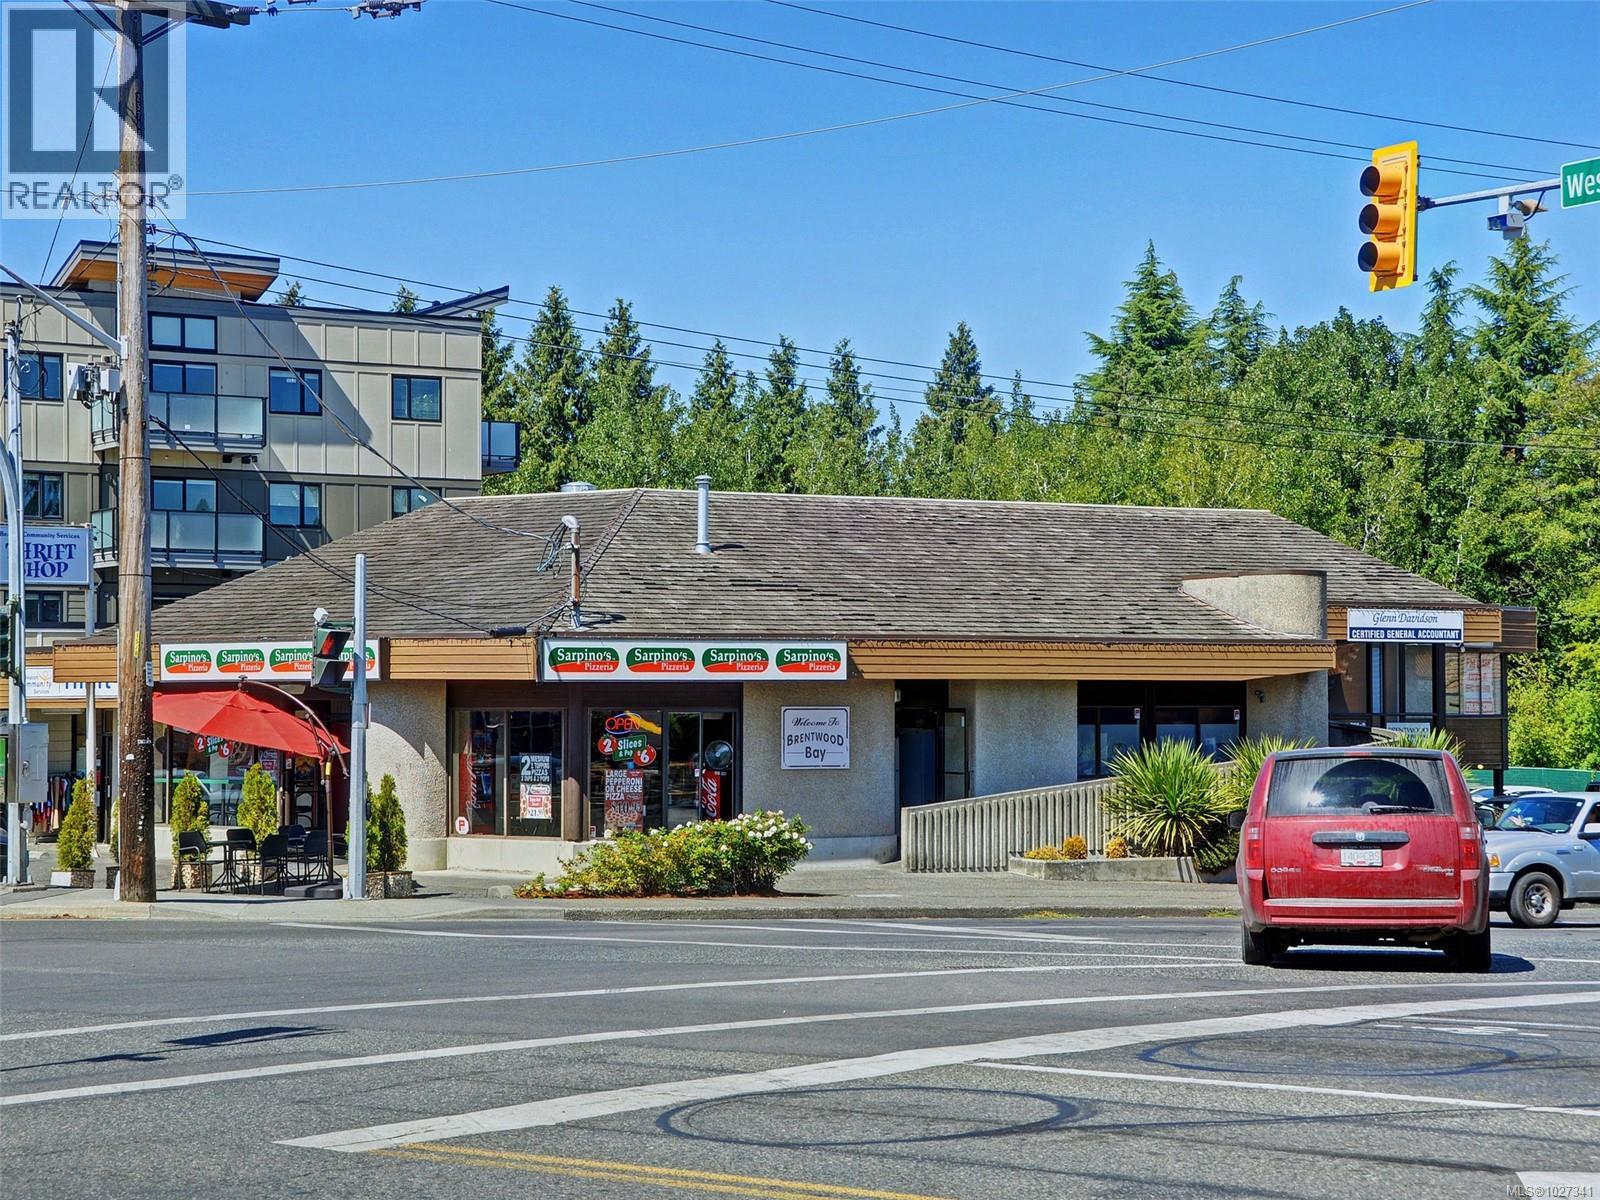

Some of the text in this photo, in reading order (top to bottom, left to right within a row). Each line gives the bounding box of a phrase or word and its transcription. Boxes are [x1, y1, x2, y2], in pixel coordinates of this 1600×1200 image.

[6, 542, 76, 561] HRIFT
[24, 561, 68, 578] HOP
[1372, 612, 1438, 625] Glenn Davidson
[1351, 630, 1460, 639] CERTIFIED GENERAL ACCOUNTANT
[170, 651, 207, 666] Sarpino's
[222, 650, 260, 665] Sarpino's
[275, 649, 313, 664] Sarpino's
[557, 649, 612, 664] Sarpino's
[634, 649, 688, 664] Sarpino's
[710, 649, 762, 664] Sarpino's
[783, 649, 834, 664] Sarpino's
[188, 664, 208, 672] Pizzeria
[240, 662, 261, 671] Pizzeria
[294, 662, 313, 671] Pizzeri
[584, 662, 614, 671] Pizzeria
[661, 662, 690, 671] Pizzeria
[736, 662, 764, 671] Pizzeria
[808, 662, 836, 671] Pizzeria
[606, 717, 640, 730] OPEN
[791, 717, 840, 727] Welcome To
[197, 737, 204, 750] 2
[603, 738, 642, 752] 2 Slices
[787, 732, 844, 746] BRENTWOOD
[805, 746, 826, 762] Bay
[520, 755, 531, 776] 2
[605, 777, 643, 785] PEPPERONI
